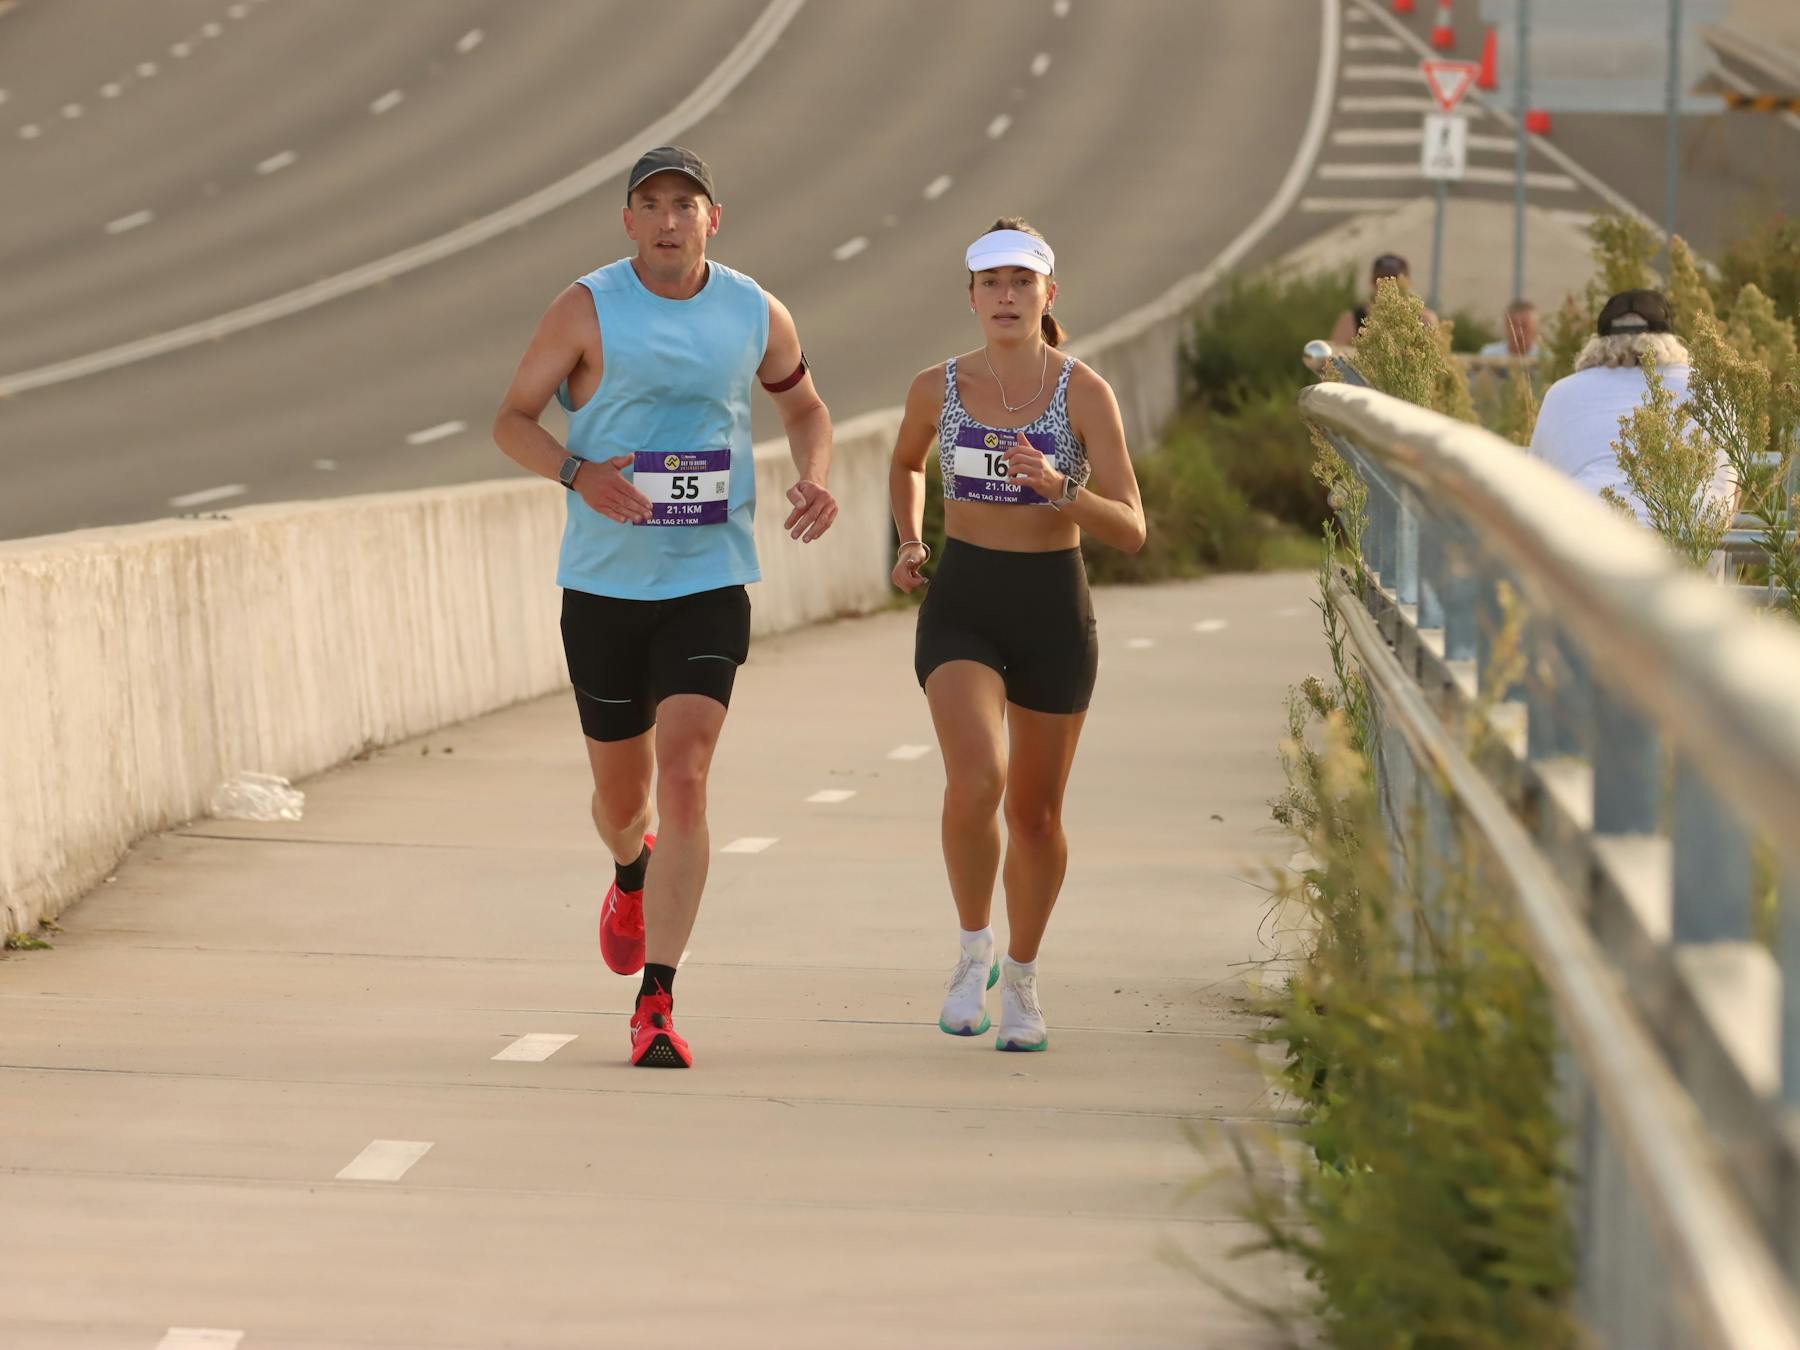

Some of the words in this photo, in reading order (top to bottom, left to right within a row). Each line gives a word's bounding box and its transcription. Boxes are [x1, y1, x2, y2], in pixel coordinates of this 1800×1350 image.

[671, 476, 699, 499] 55
[985, 482, 1022, 492] 21.1KM
[968, 491, 981, 499] BAG
[666, 505, 702, 514] 21.1KM
